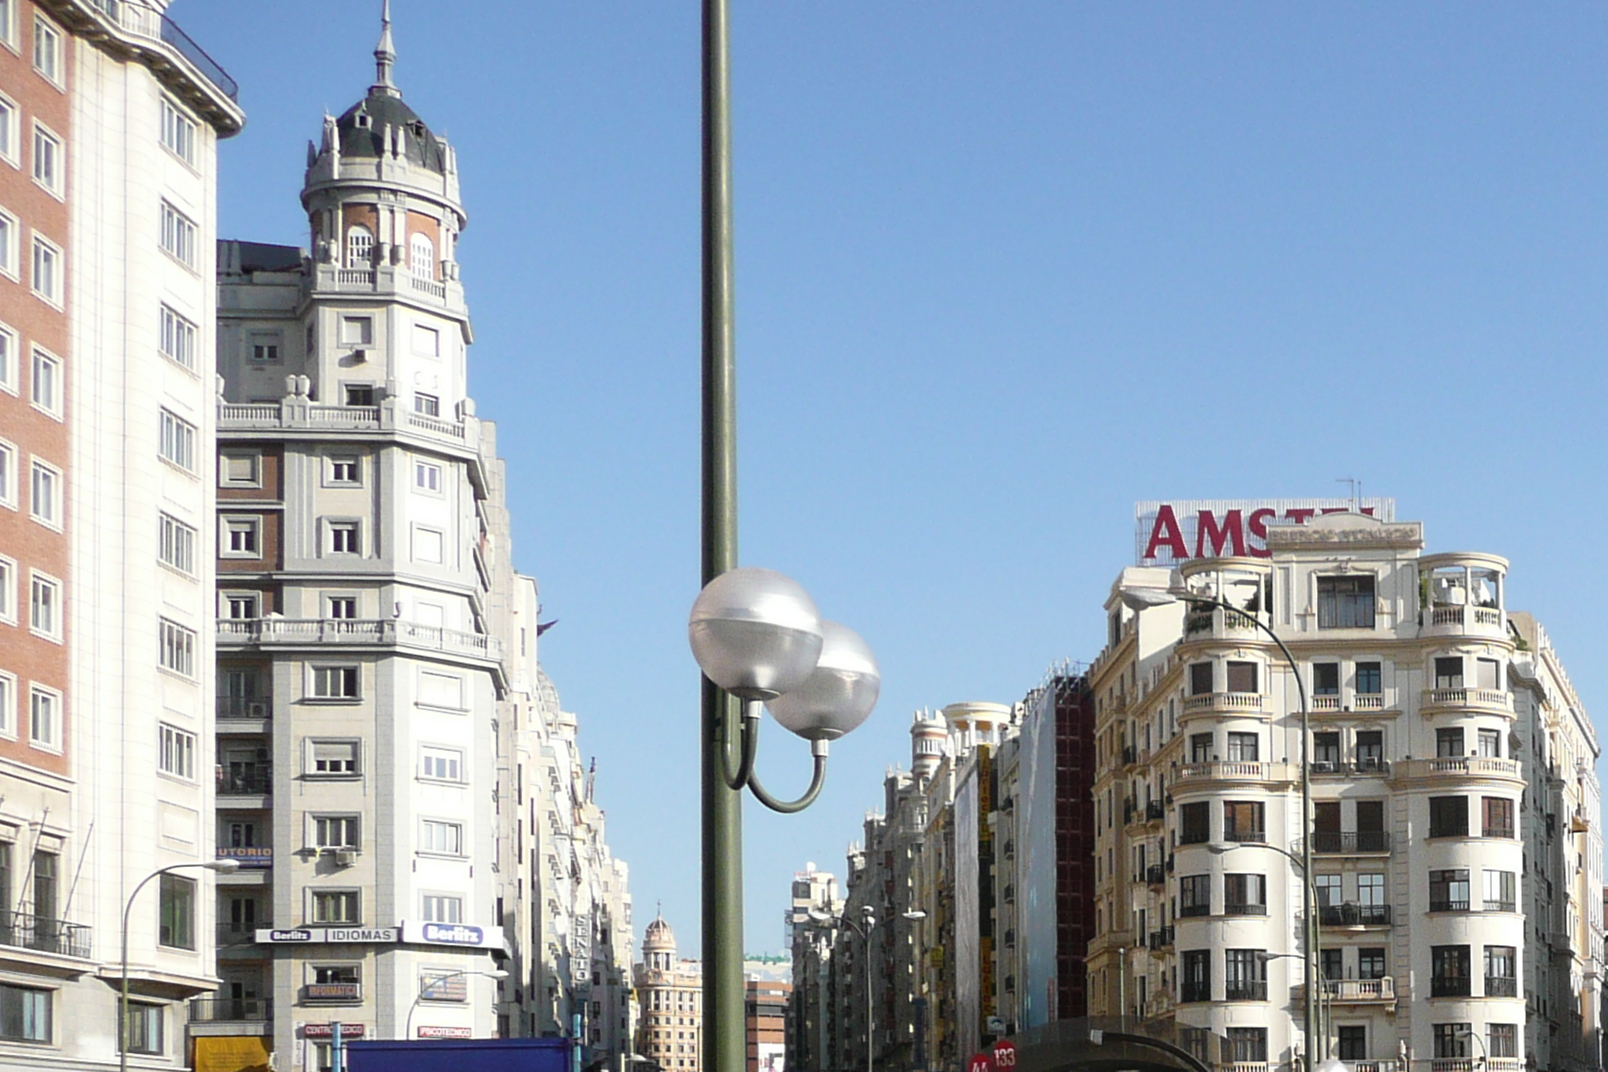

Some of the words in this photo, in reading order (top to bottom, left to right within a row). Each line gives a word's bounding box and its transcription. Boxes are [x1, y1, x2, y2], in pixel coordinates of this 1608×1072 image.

[1143, 504, 1375, 559] AMST
[217, 847, 272, 857] UTORIO
[273, 930, 308, 941] Berlitz
[332, 929, 392, 941] IDIOMAS
[426, 925, 480, 942] Berlitz
[993, 1049, 1016, 1067] 133
